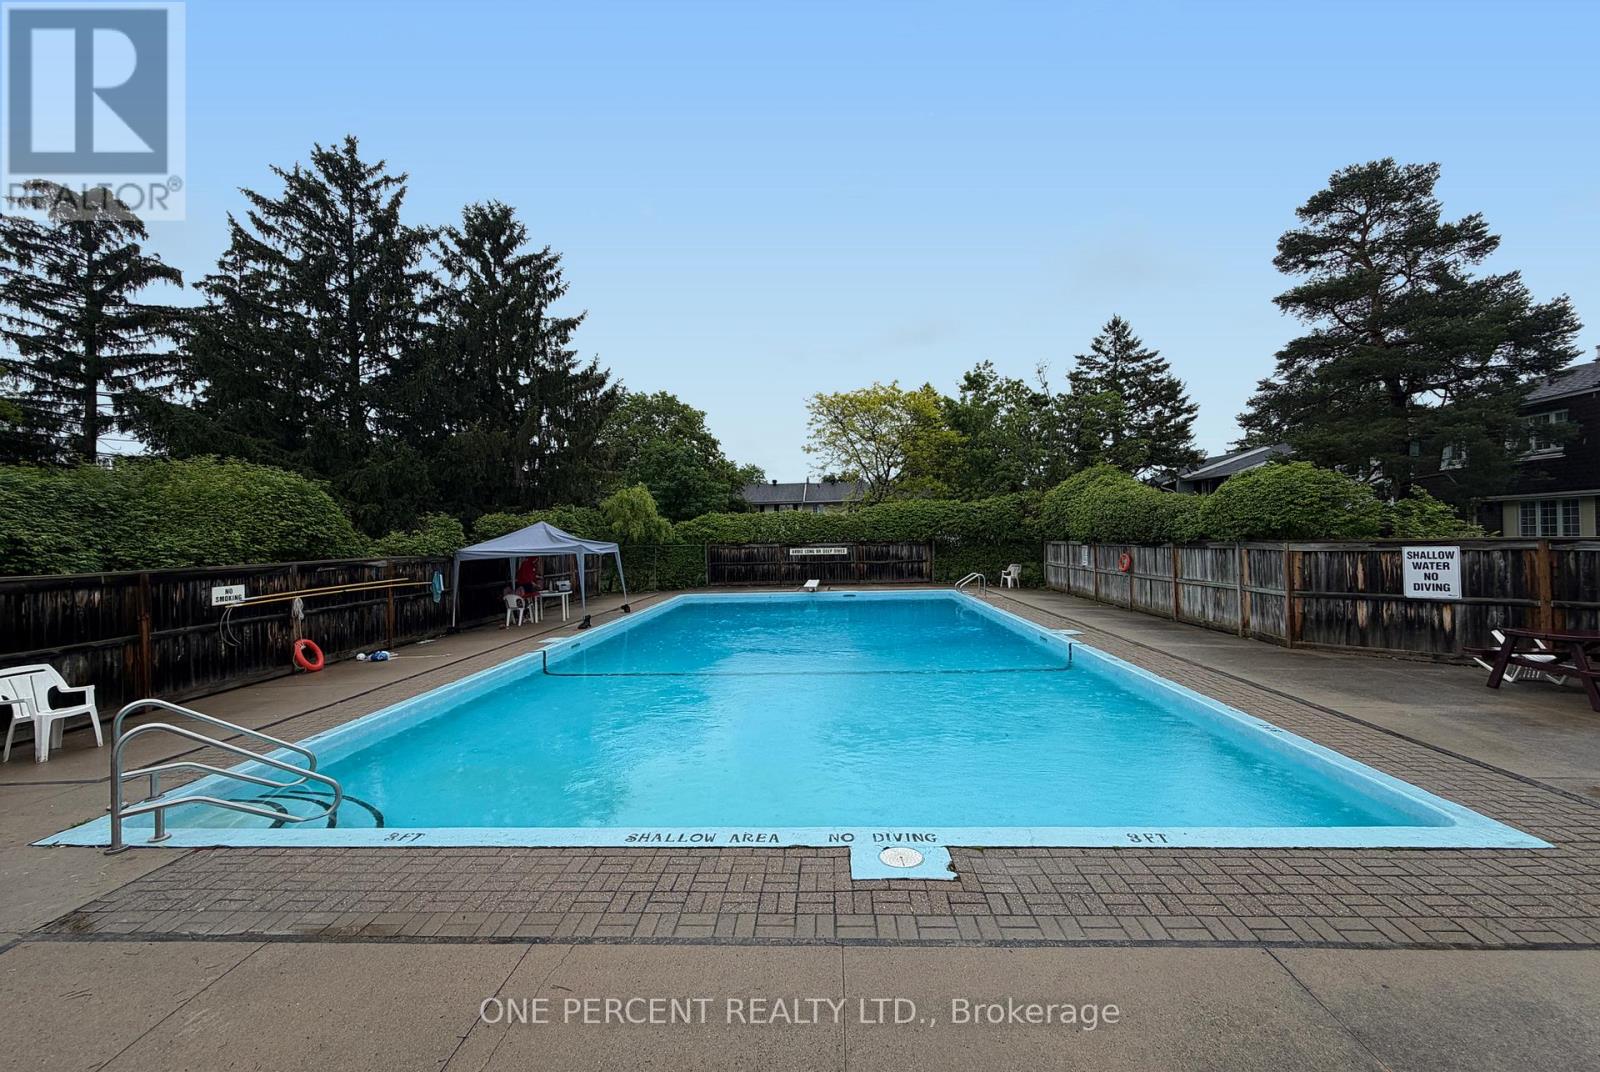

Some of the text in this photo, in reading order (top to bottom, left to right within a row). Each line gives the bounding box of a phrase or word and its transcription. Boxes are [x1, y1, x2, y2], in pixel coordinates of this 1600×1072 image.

[1406, 550, 1455, 560] SHALLOW
[1412, 561, 1450, 570] WATER
[1424, 572, 1439, 581] NO
[1413, 582, 1451, 592] DIVING
[215, 594, 242, 602] SMOKING
[625, 832, 779, 843] SHALLOW AREA
[828, 832, 937, 843] NO DIVING
